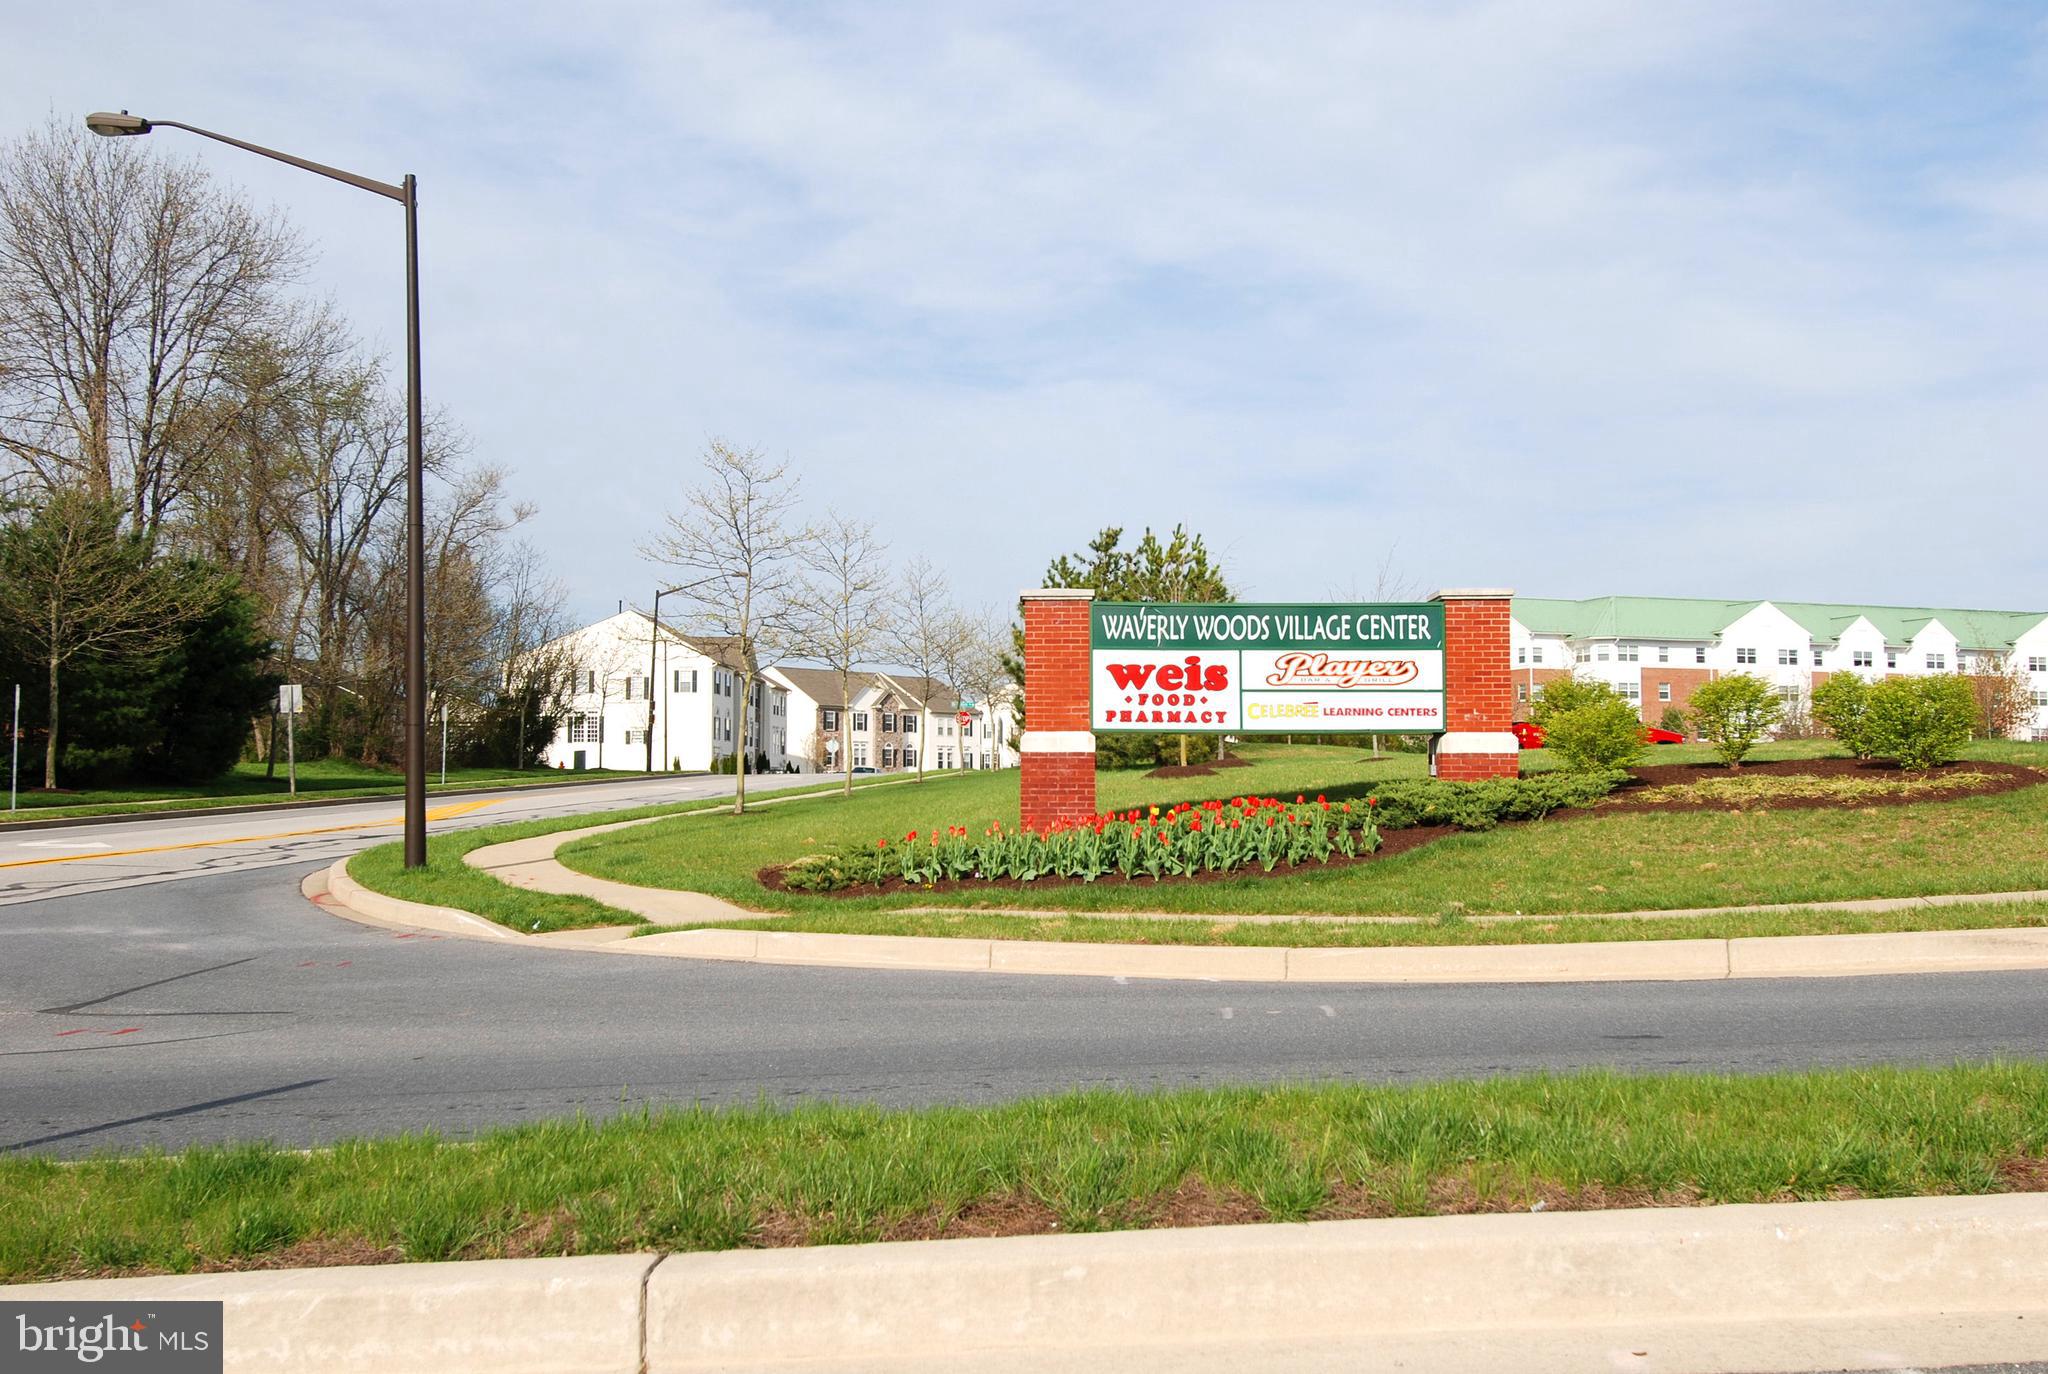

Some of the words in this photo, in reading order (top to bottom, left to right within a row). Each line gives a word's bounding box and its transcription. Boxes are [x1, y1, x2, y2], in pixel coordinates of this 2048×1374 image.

[1101, 614, 1189, 641] WAVERLY
[1193, 614, 1270, 641] WOODS
[1274, 614, 1352, 641] VILLAGE
[1356, 614, 1432, 641] CENTER
[1105, 655, 1229, 692] weis
[1266, 652, 1419, 688] Players
[1137, 693, 1196, 706] FOOD
[1105, 710, 1228, 723] PHARMACY
[1322, 707, 1384, 717] LEARNING
[1387, 707, 1438, 717] CENTERS
